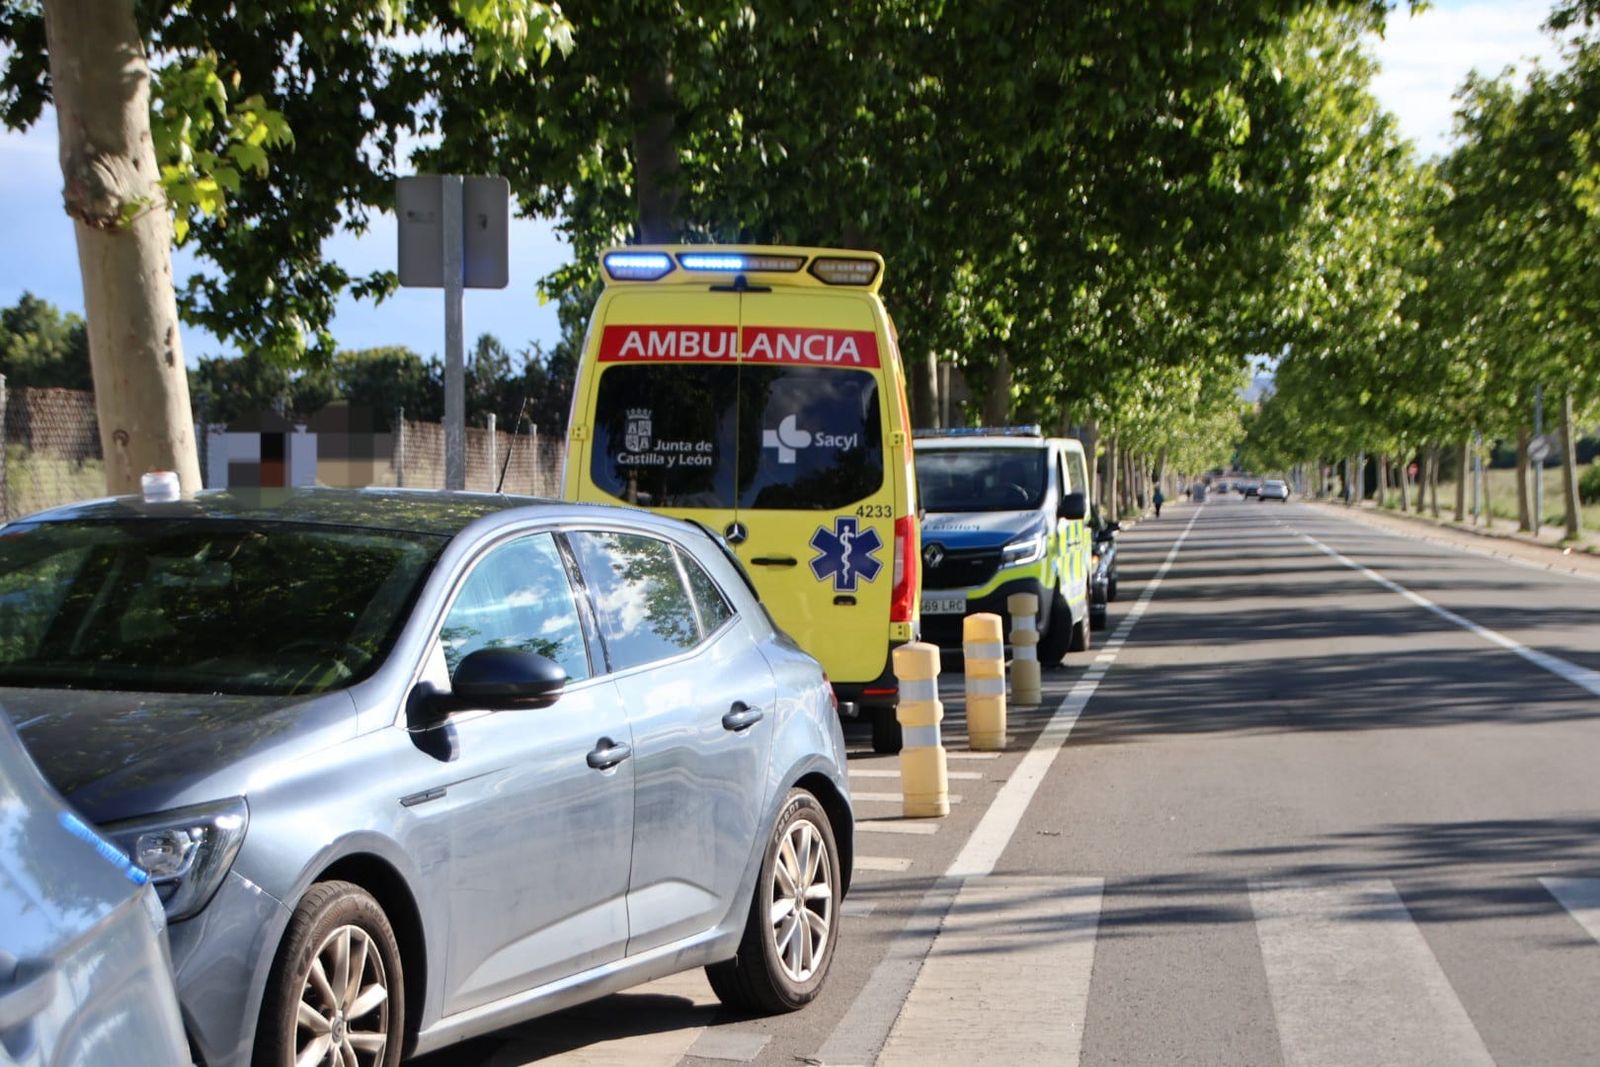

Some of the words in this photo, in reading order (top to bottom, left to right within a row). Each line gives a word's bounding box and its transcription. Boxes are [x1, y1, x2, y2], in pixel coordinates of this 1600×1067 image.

[618, 330, 862, 362] AMBULANCIA
[653, 440, 692, 452] Junta
[695, 440, 713, 452] de
[815, 432, 858, 451] Sacyl
[617, 452, 665, 464] Castilla
[666, 455, 676, 468] y
[679, 453, 712, 465] León
[856, 505, 892, 518] 4233
